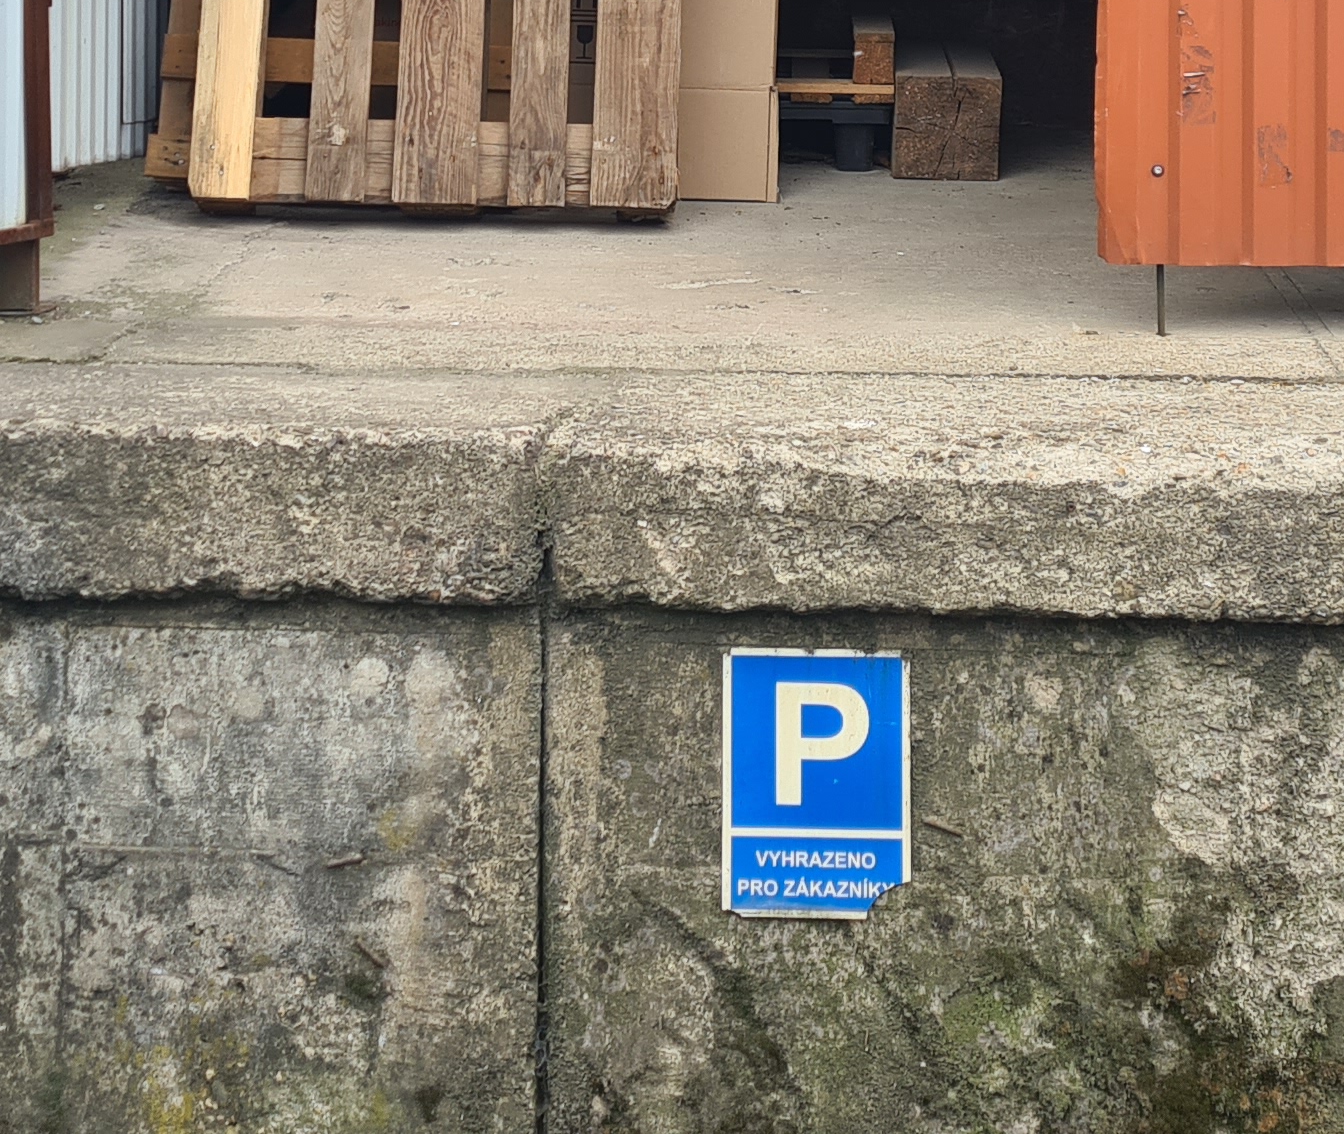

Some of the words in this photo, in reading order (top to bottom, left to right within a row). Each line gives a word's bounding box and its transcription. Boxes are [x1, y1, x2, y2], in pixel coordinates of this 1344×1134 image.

[775, 681, 870, 806] P
[756, 850, 877, 870] VYHRAZENO
[737, 879, 778, 897] PRO
